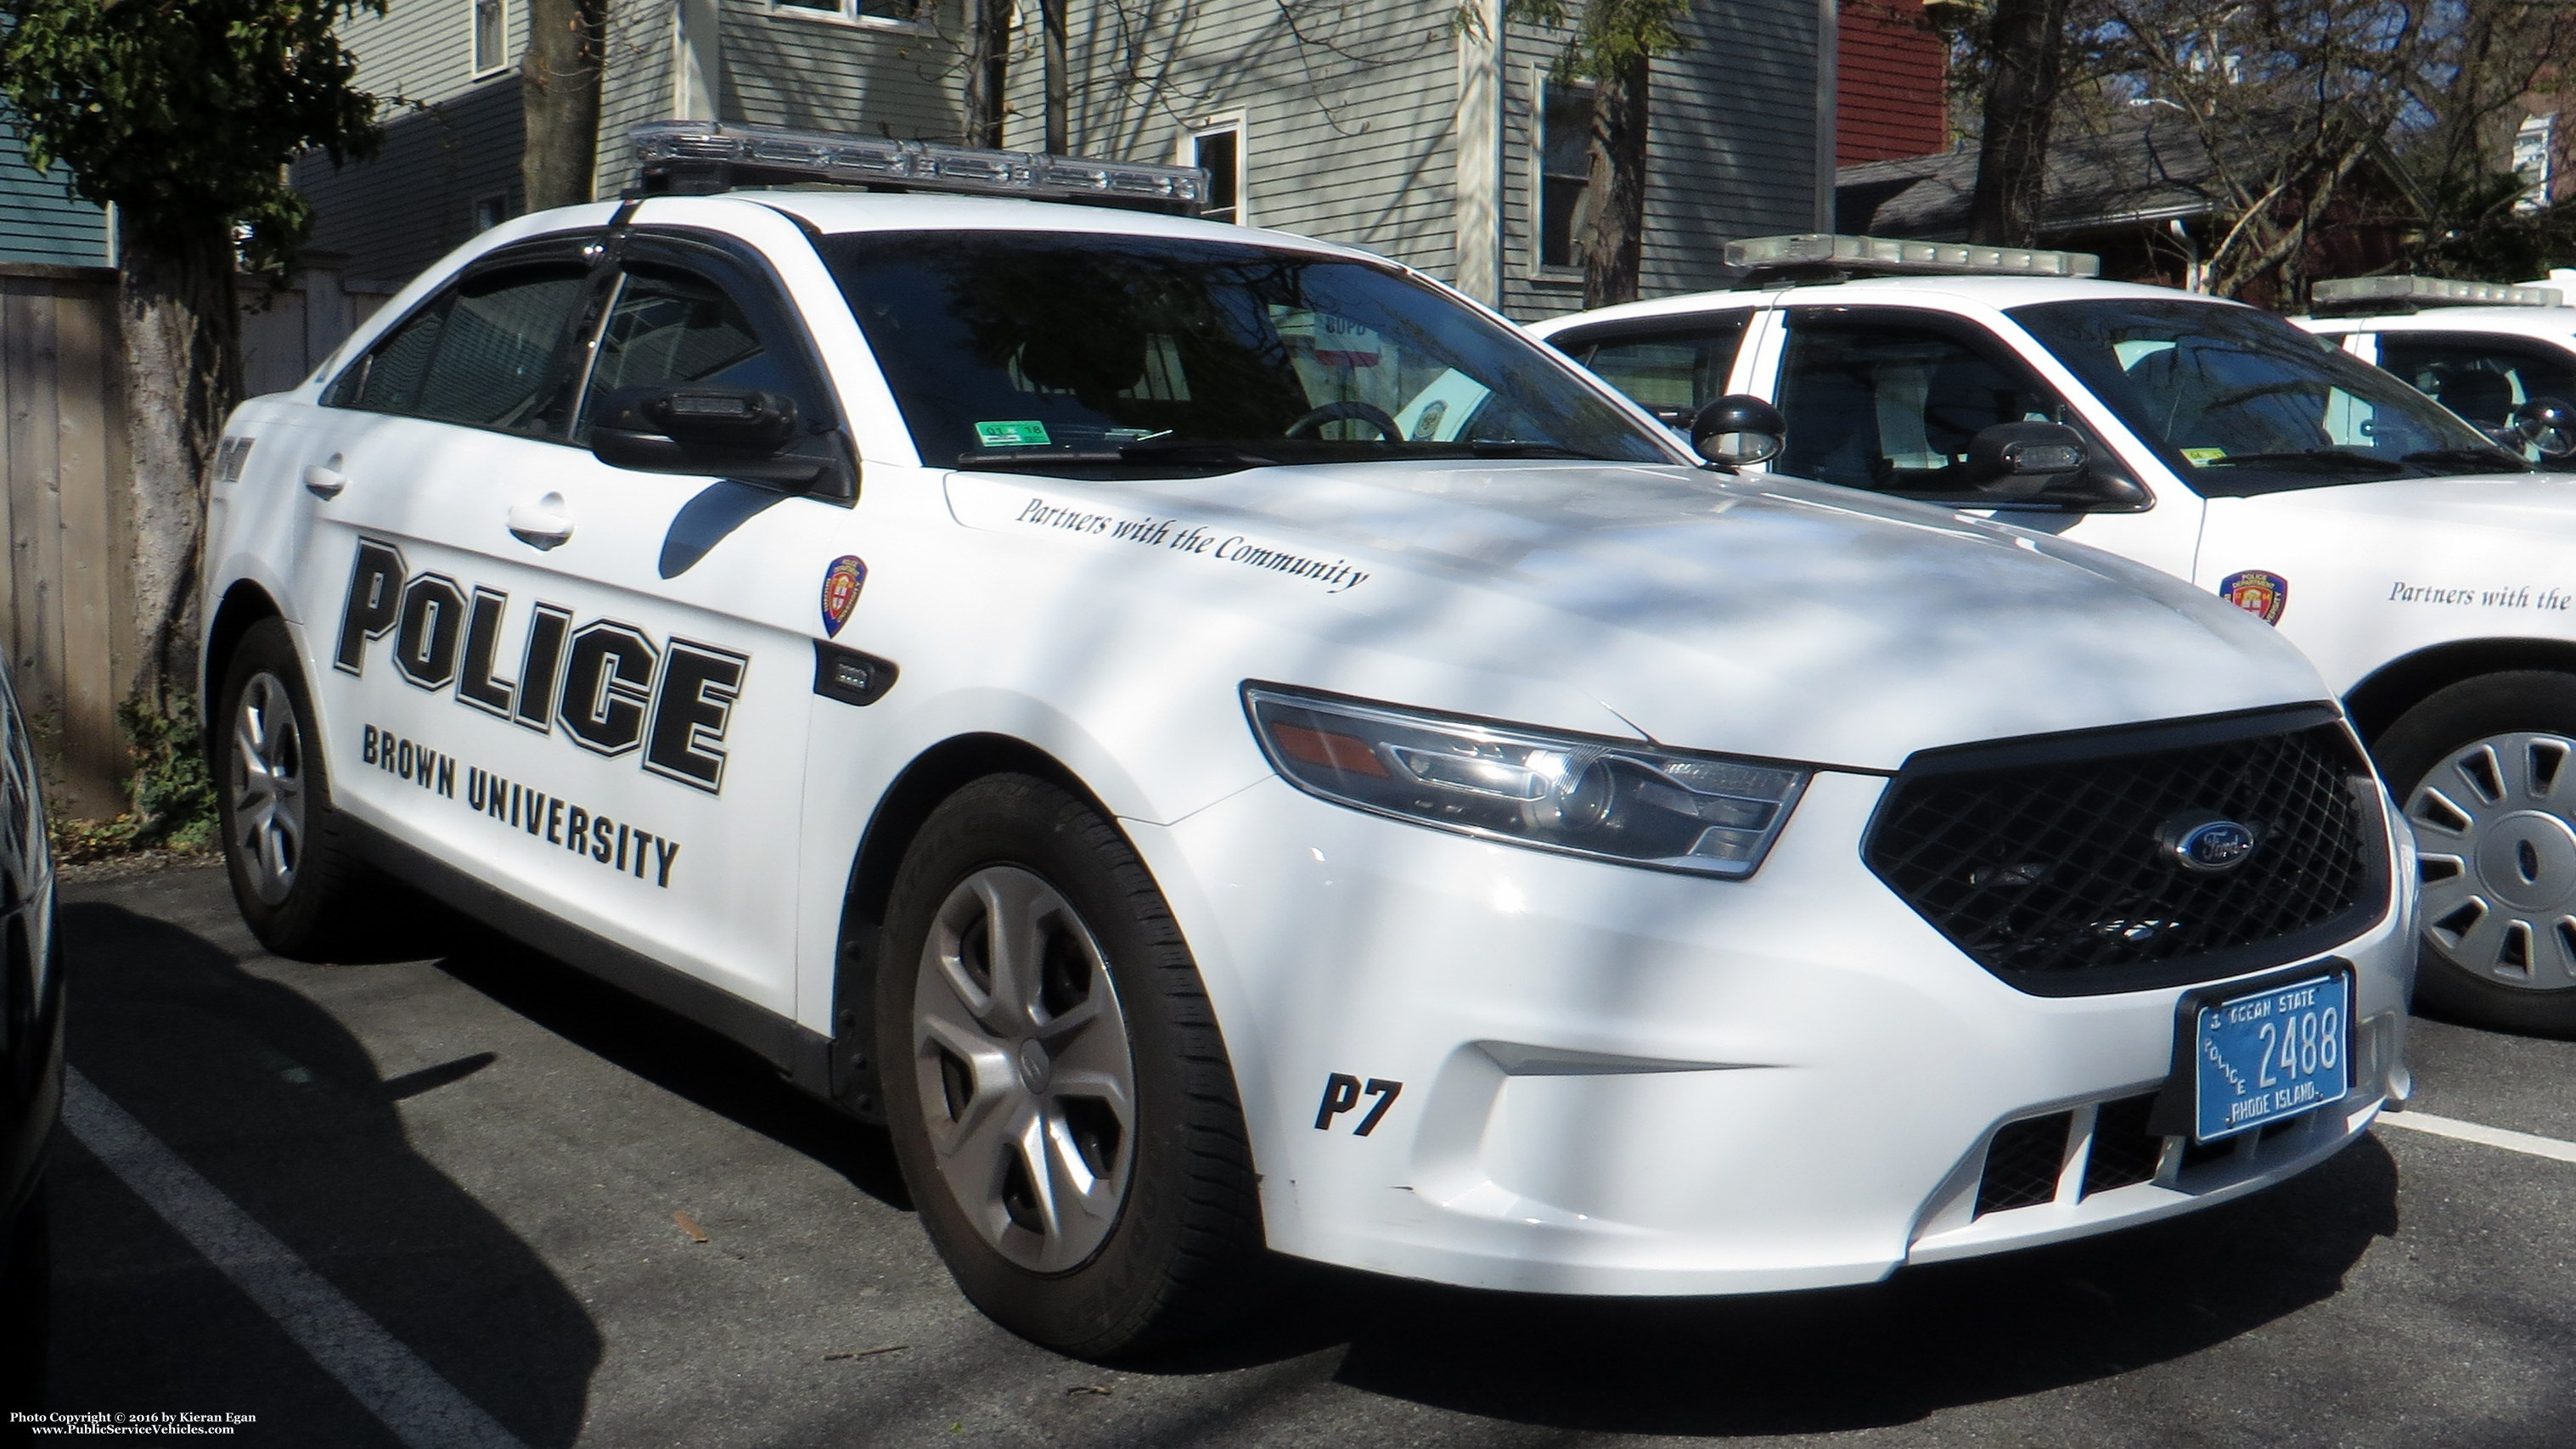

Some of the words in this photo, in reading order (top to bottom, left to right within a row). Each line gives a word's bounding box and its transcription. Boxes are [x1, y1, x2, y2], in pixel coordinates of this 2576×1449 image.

[1015, 497, 1112, 535] Partners
[1111, 516, 1177, 546] with
[1169, 525, 1216, 554] the
[1214, 536, 1372, 593] Community
[2388, 581, 2476, 606] Partners
[2481, 585, 2530, 609] with
[2536, 587, 2573, 611] the
[333, 534, 752, 800] POLICE
[363, 723, 457, 800] BROWN
[469, 767, 681, 889] UNIVERSITY
[2203, 831, 2241, 861] Ford
[2230, 1000, 2271, 1024] OCEAN
[2279, 989, 2316, 1013] STATE
[2204, 1037, 2247, 1096] POLICE
[2258, 1006, 2337, 1089] 2488
[1313, 1071, 1404, 1137] P7
[2231, 1093, 2271, 1123] RHODE
[2275, 1081, 2315, 1110] ISLAND
